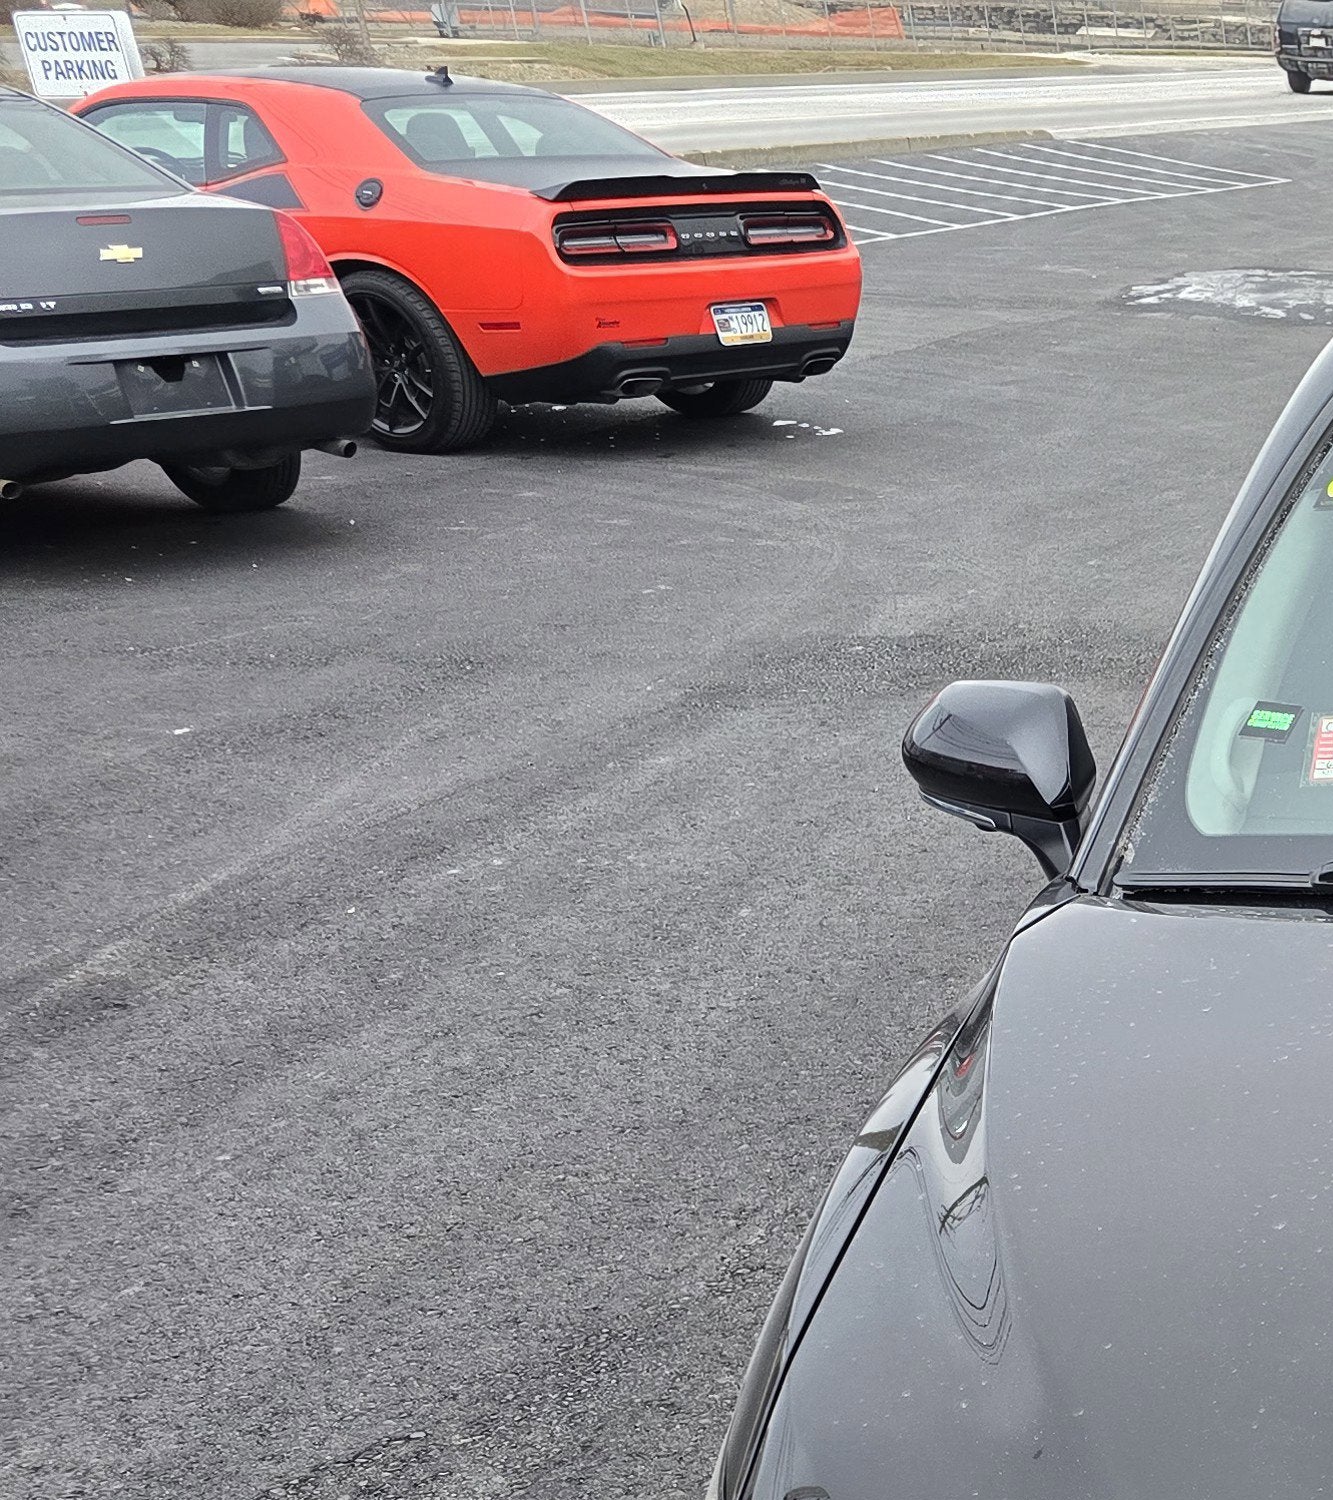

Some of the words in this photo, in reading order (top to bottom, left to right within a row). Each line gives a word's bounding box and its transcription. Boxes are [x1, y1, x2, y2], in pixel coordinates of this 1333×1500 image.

[24, 31, 120, 52] CUSTOMER
[41, 59, 118, 80] PARKING
[735, 313, 768, 335] 19912
